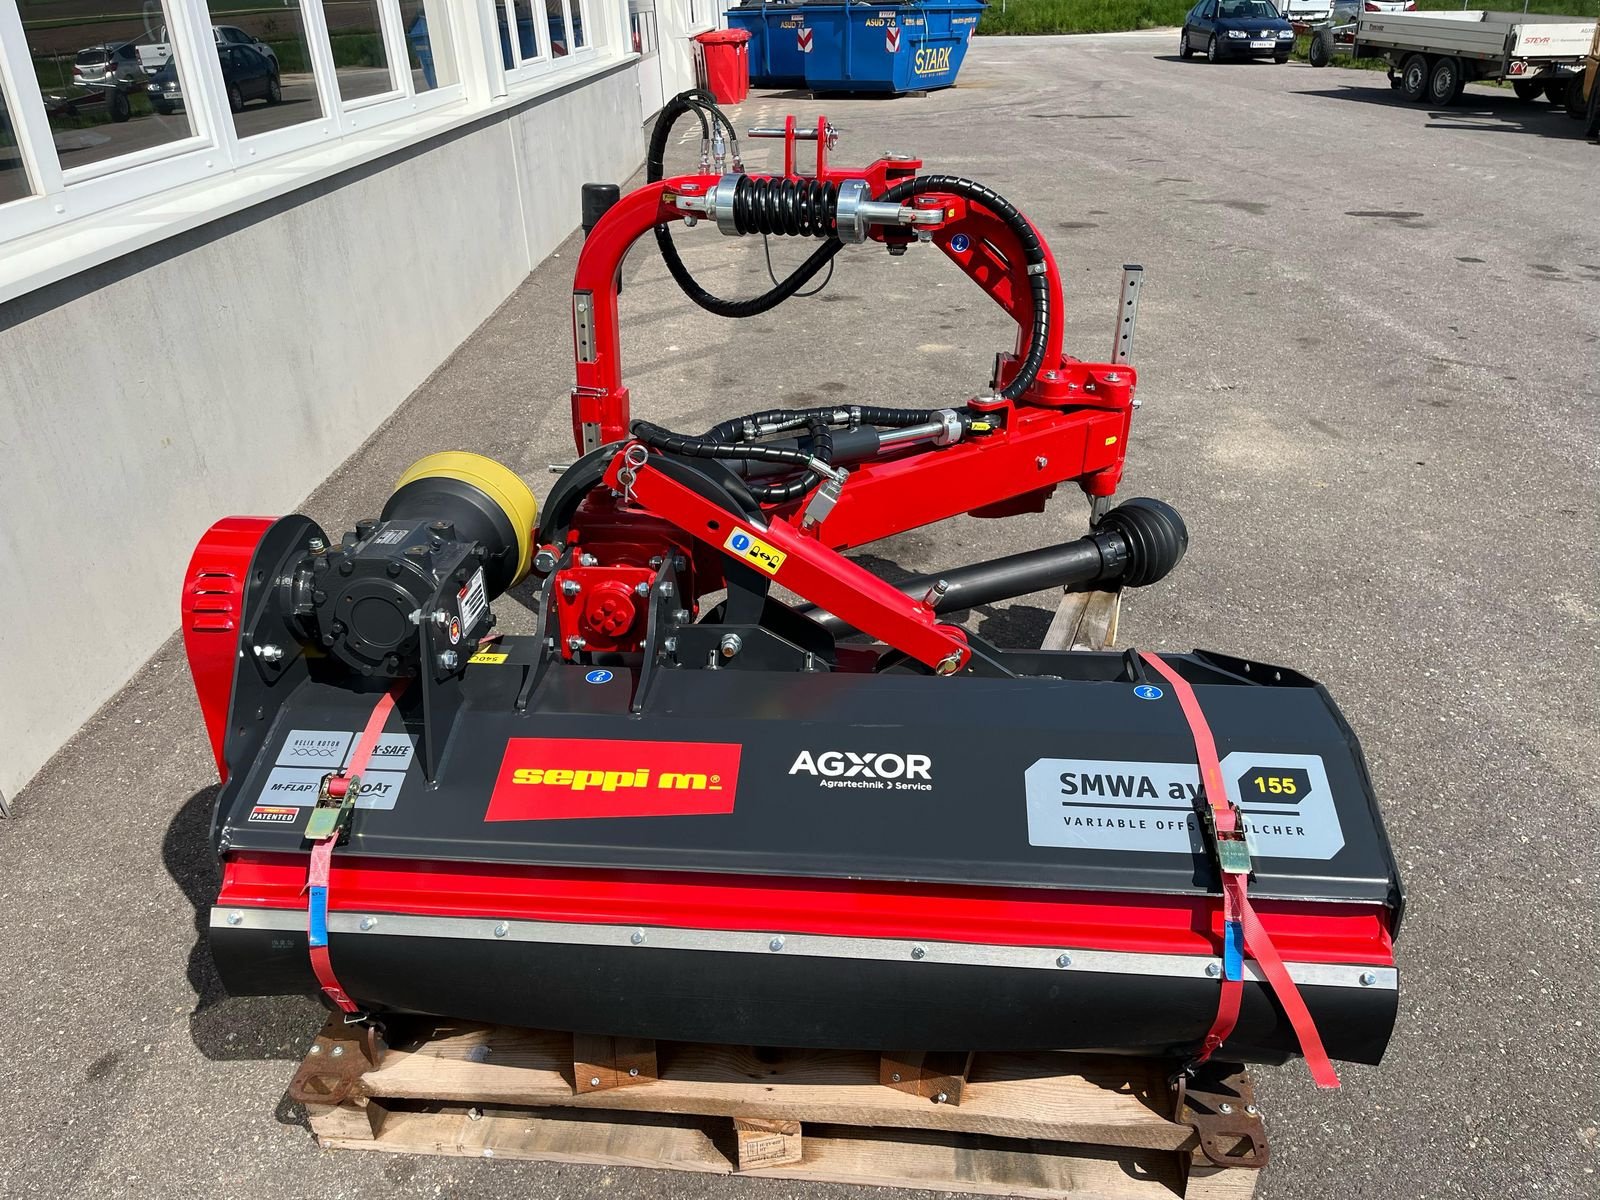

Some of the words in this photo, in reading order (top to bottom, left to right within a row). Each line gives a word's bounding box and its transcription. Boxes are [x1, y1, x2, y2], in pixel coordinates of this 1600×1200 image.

[780, 20, 796, 29] ASUD
[865, 18, 884, 27] ASUD
[886, 18, 896, 27] 76
[914, 46, 952, 75] STARK
[294, 739, 314, 747] HELIX
[317, 740, 341, 748] ROTOR
[788, 750, 932, 780] AGXOR
[512, 768, 650, 792] seppi
[819, 779, 884, 789] Agrartechnik
[895, 782, 932, 791] Service
[1060, 772, 1159, 800] SMWA
[1253, 776, 1297, 795] 155
[270, 783, 313, 792] M-FLAP
[251, 812, 294, 821] PATENTED
[1063, 816, 1147, 830] VARIABLE
[1156, 820, 1196, 832] OFFS
